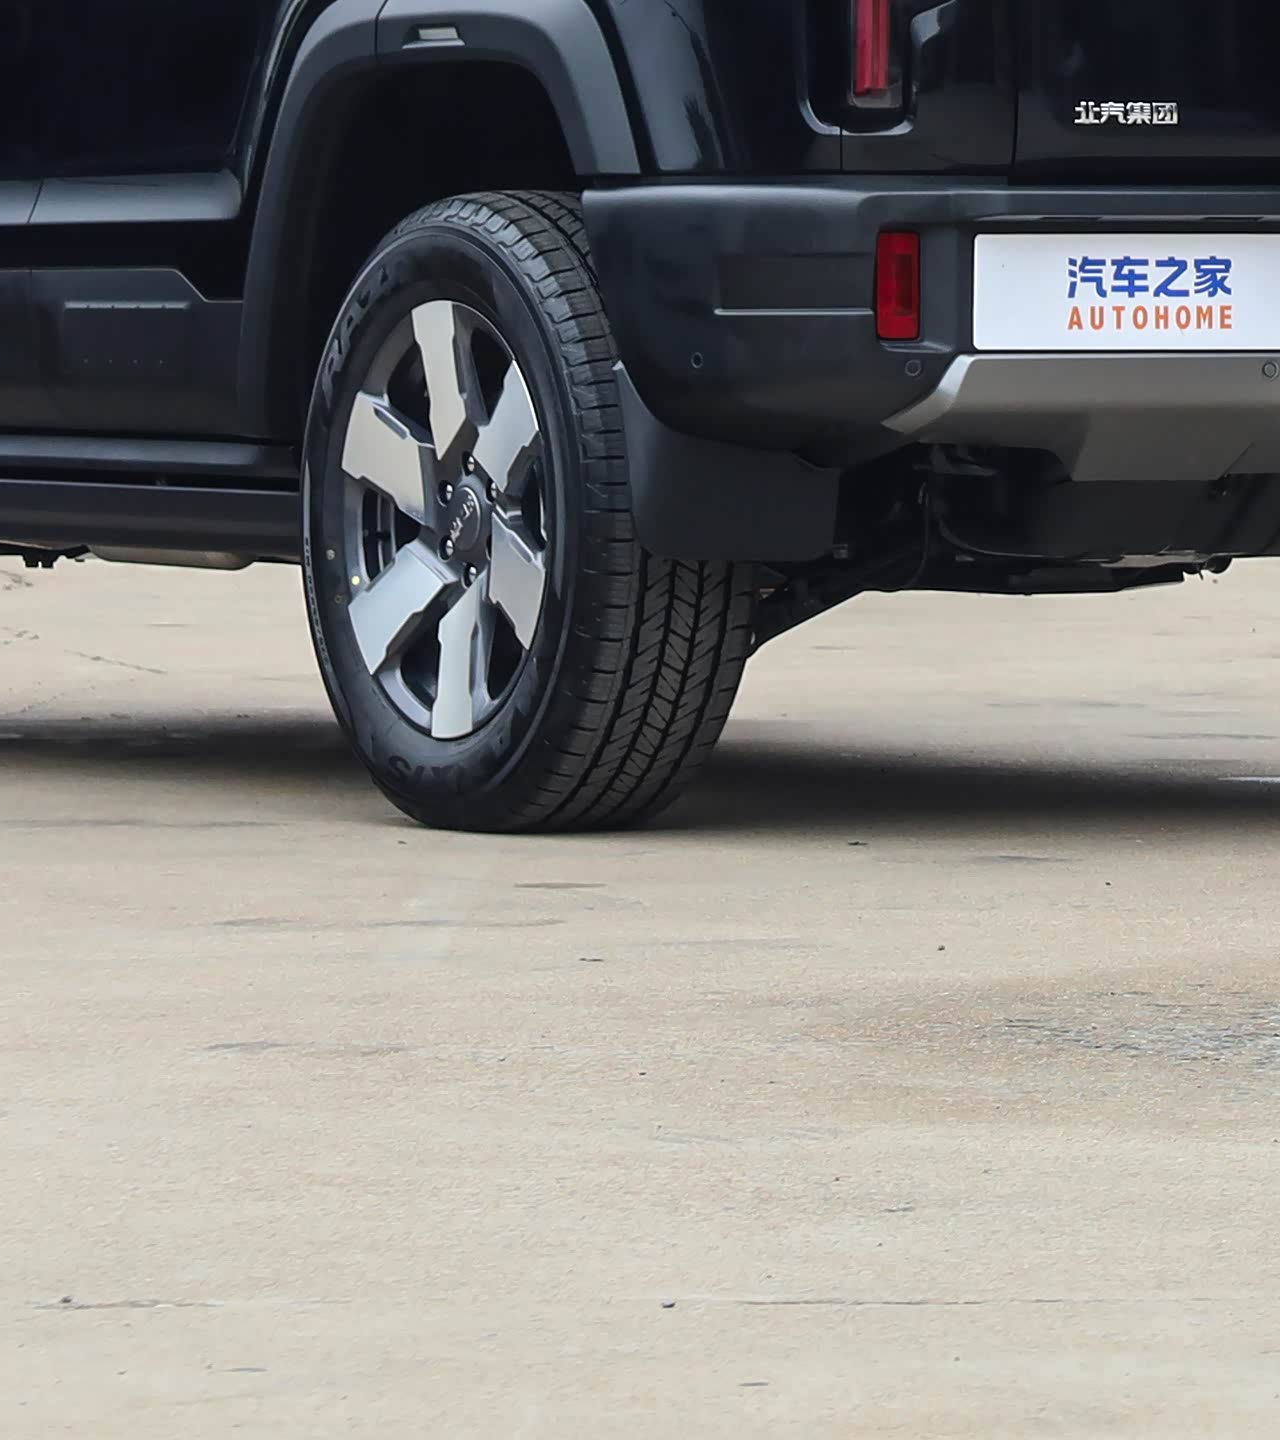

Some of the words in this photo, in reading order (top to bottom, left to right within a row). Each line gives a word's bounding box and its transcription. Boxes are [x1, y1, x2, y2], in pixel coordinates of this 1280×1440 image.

[1067, 256, 1232, 298] 汽车之家
[1067, 305, 1232, 330] AUTOHOME
